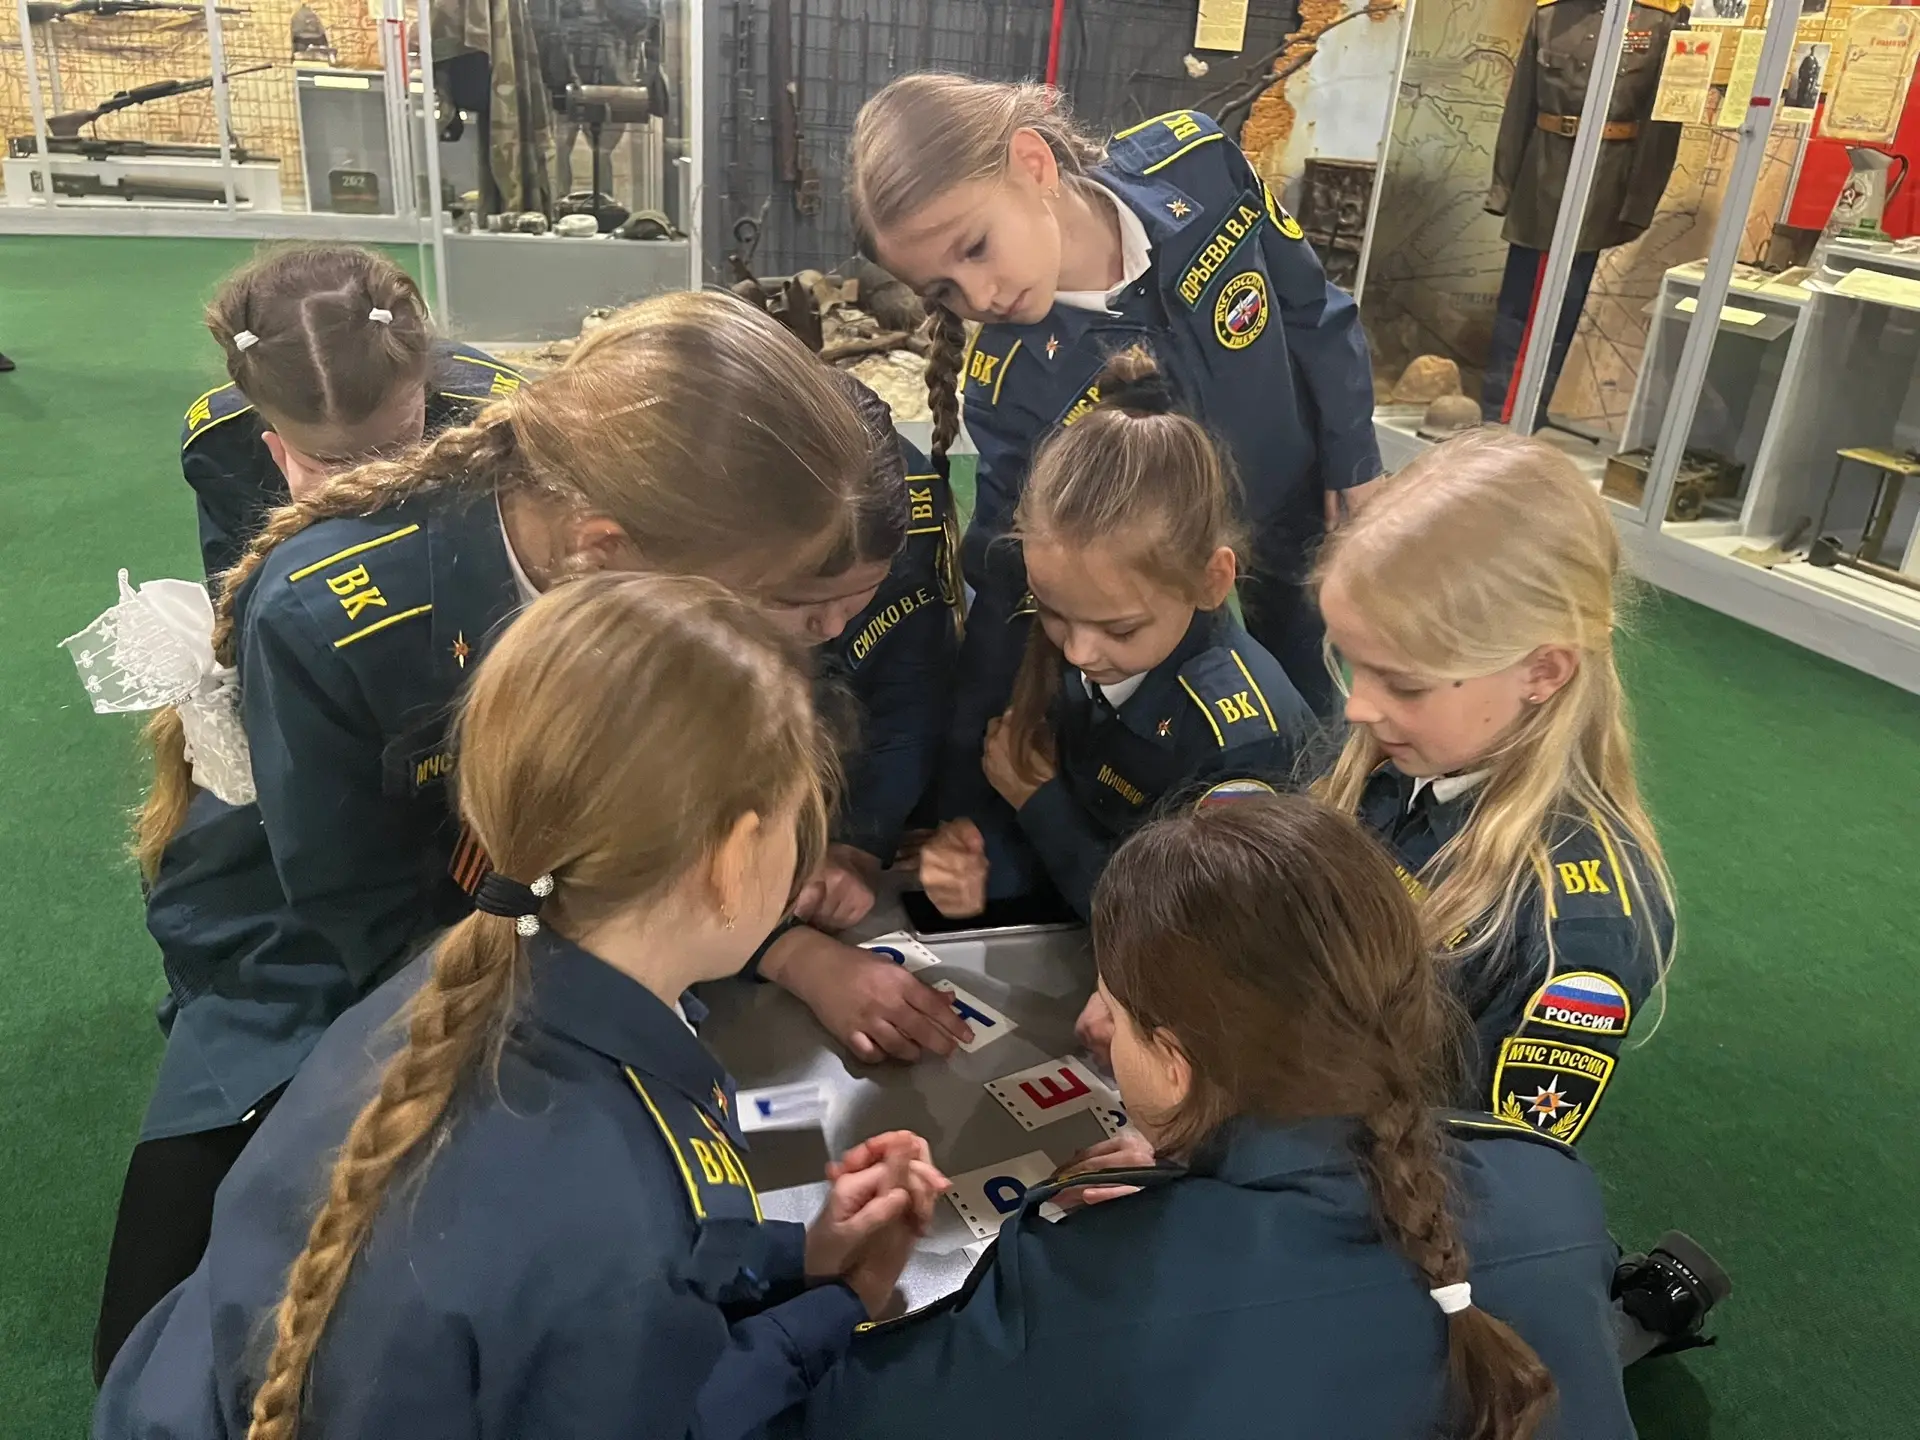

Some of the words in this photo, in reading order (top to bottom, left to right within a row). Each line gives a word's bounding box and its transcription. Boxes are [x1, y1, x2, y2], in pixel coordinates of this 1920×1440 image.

[1163, 114, 1201, 141] ВК
[1179, 232, 1236, 304] ЮРЬЕВА
[1225, 205, 1262, 240] В.А.
[969, 350, 1000, 384] ВК
[189, 398, 211, 430] ВК
[909, 487, 933, 520] ВК
[326, 563, 387, 620] ВК
[852, 604, 900, 650] СИЛКО
[900, 587, 935, 615] В.Е.
[1215, 691, 1259, 723] ВК
[1556, 859, 1610, 894] ВК
[1545, 1006, 1615, 1030] РОССИЯ
[1507, 1043, 1545, 1063] МЧС
[1549, 1049, 1607, 1078] РОССИИ
[689, 1137, 745, 1187] ВК
